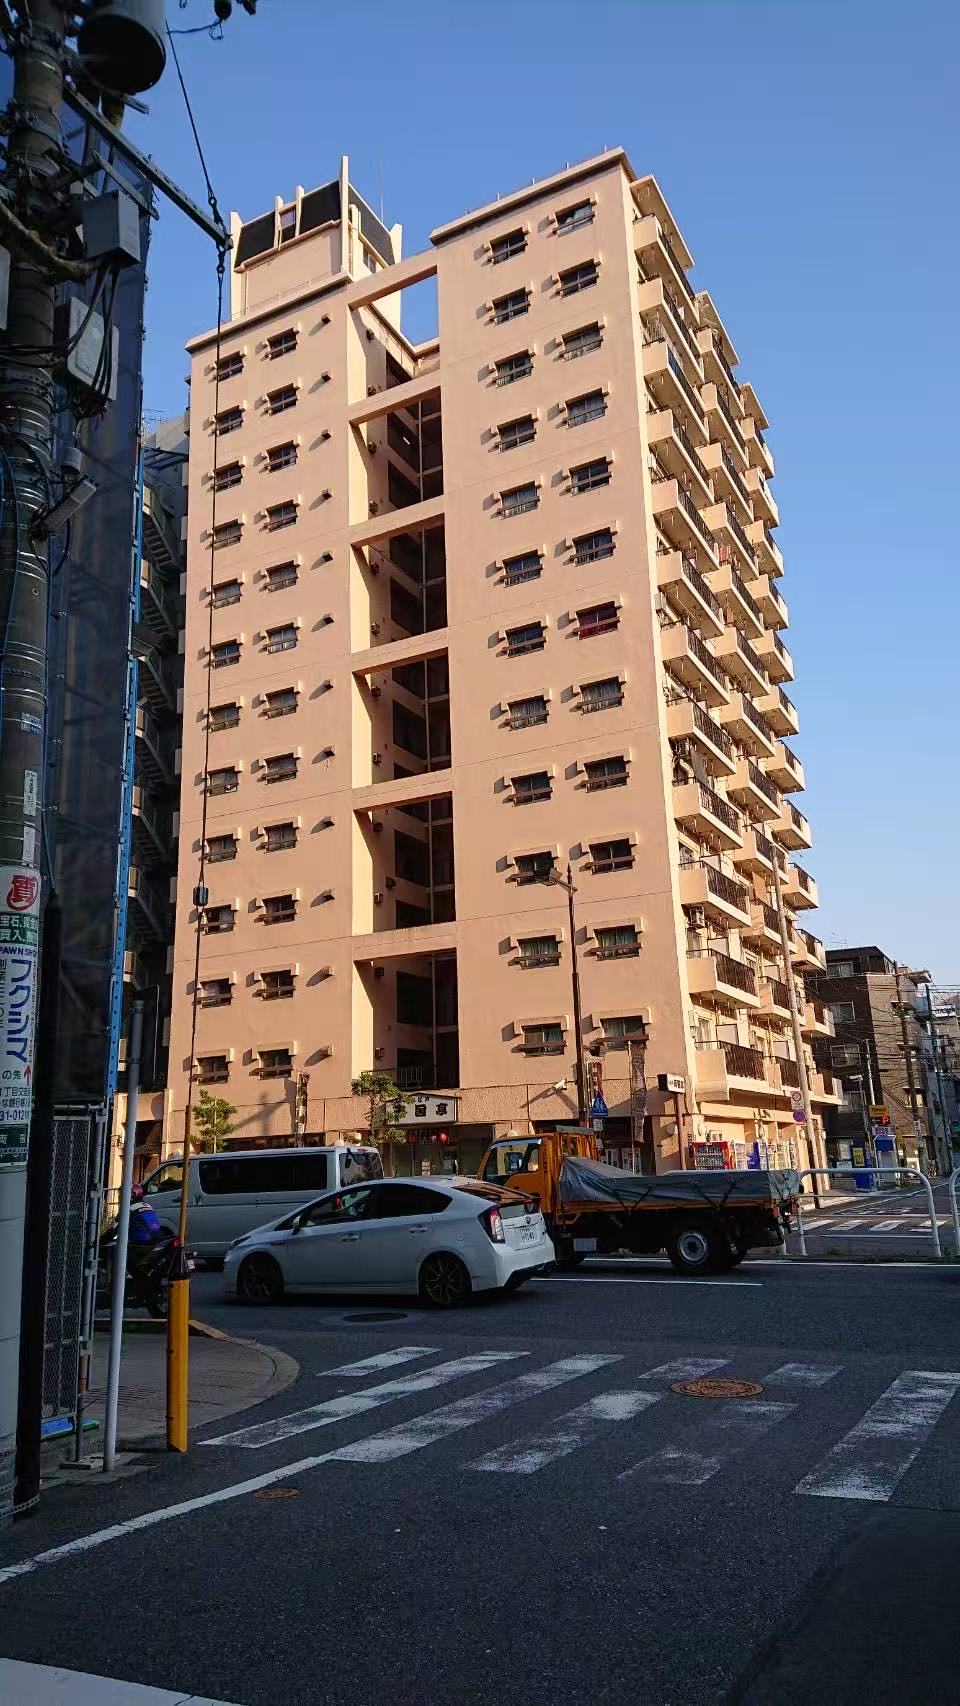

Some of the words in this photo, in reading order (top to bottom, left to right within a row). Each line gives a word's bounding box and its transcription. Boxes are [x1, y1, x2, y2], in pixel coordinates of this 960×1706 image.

[7, 958, 32, 1062] フクシマ
[2, 1070, 21, 1079] の先
